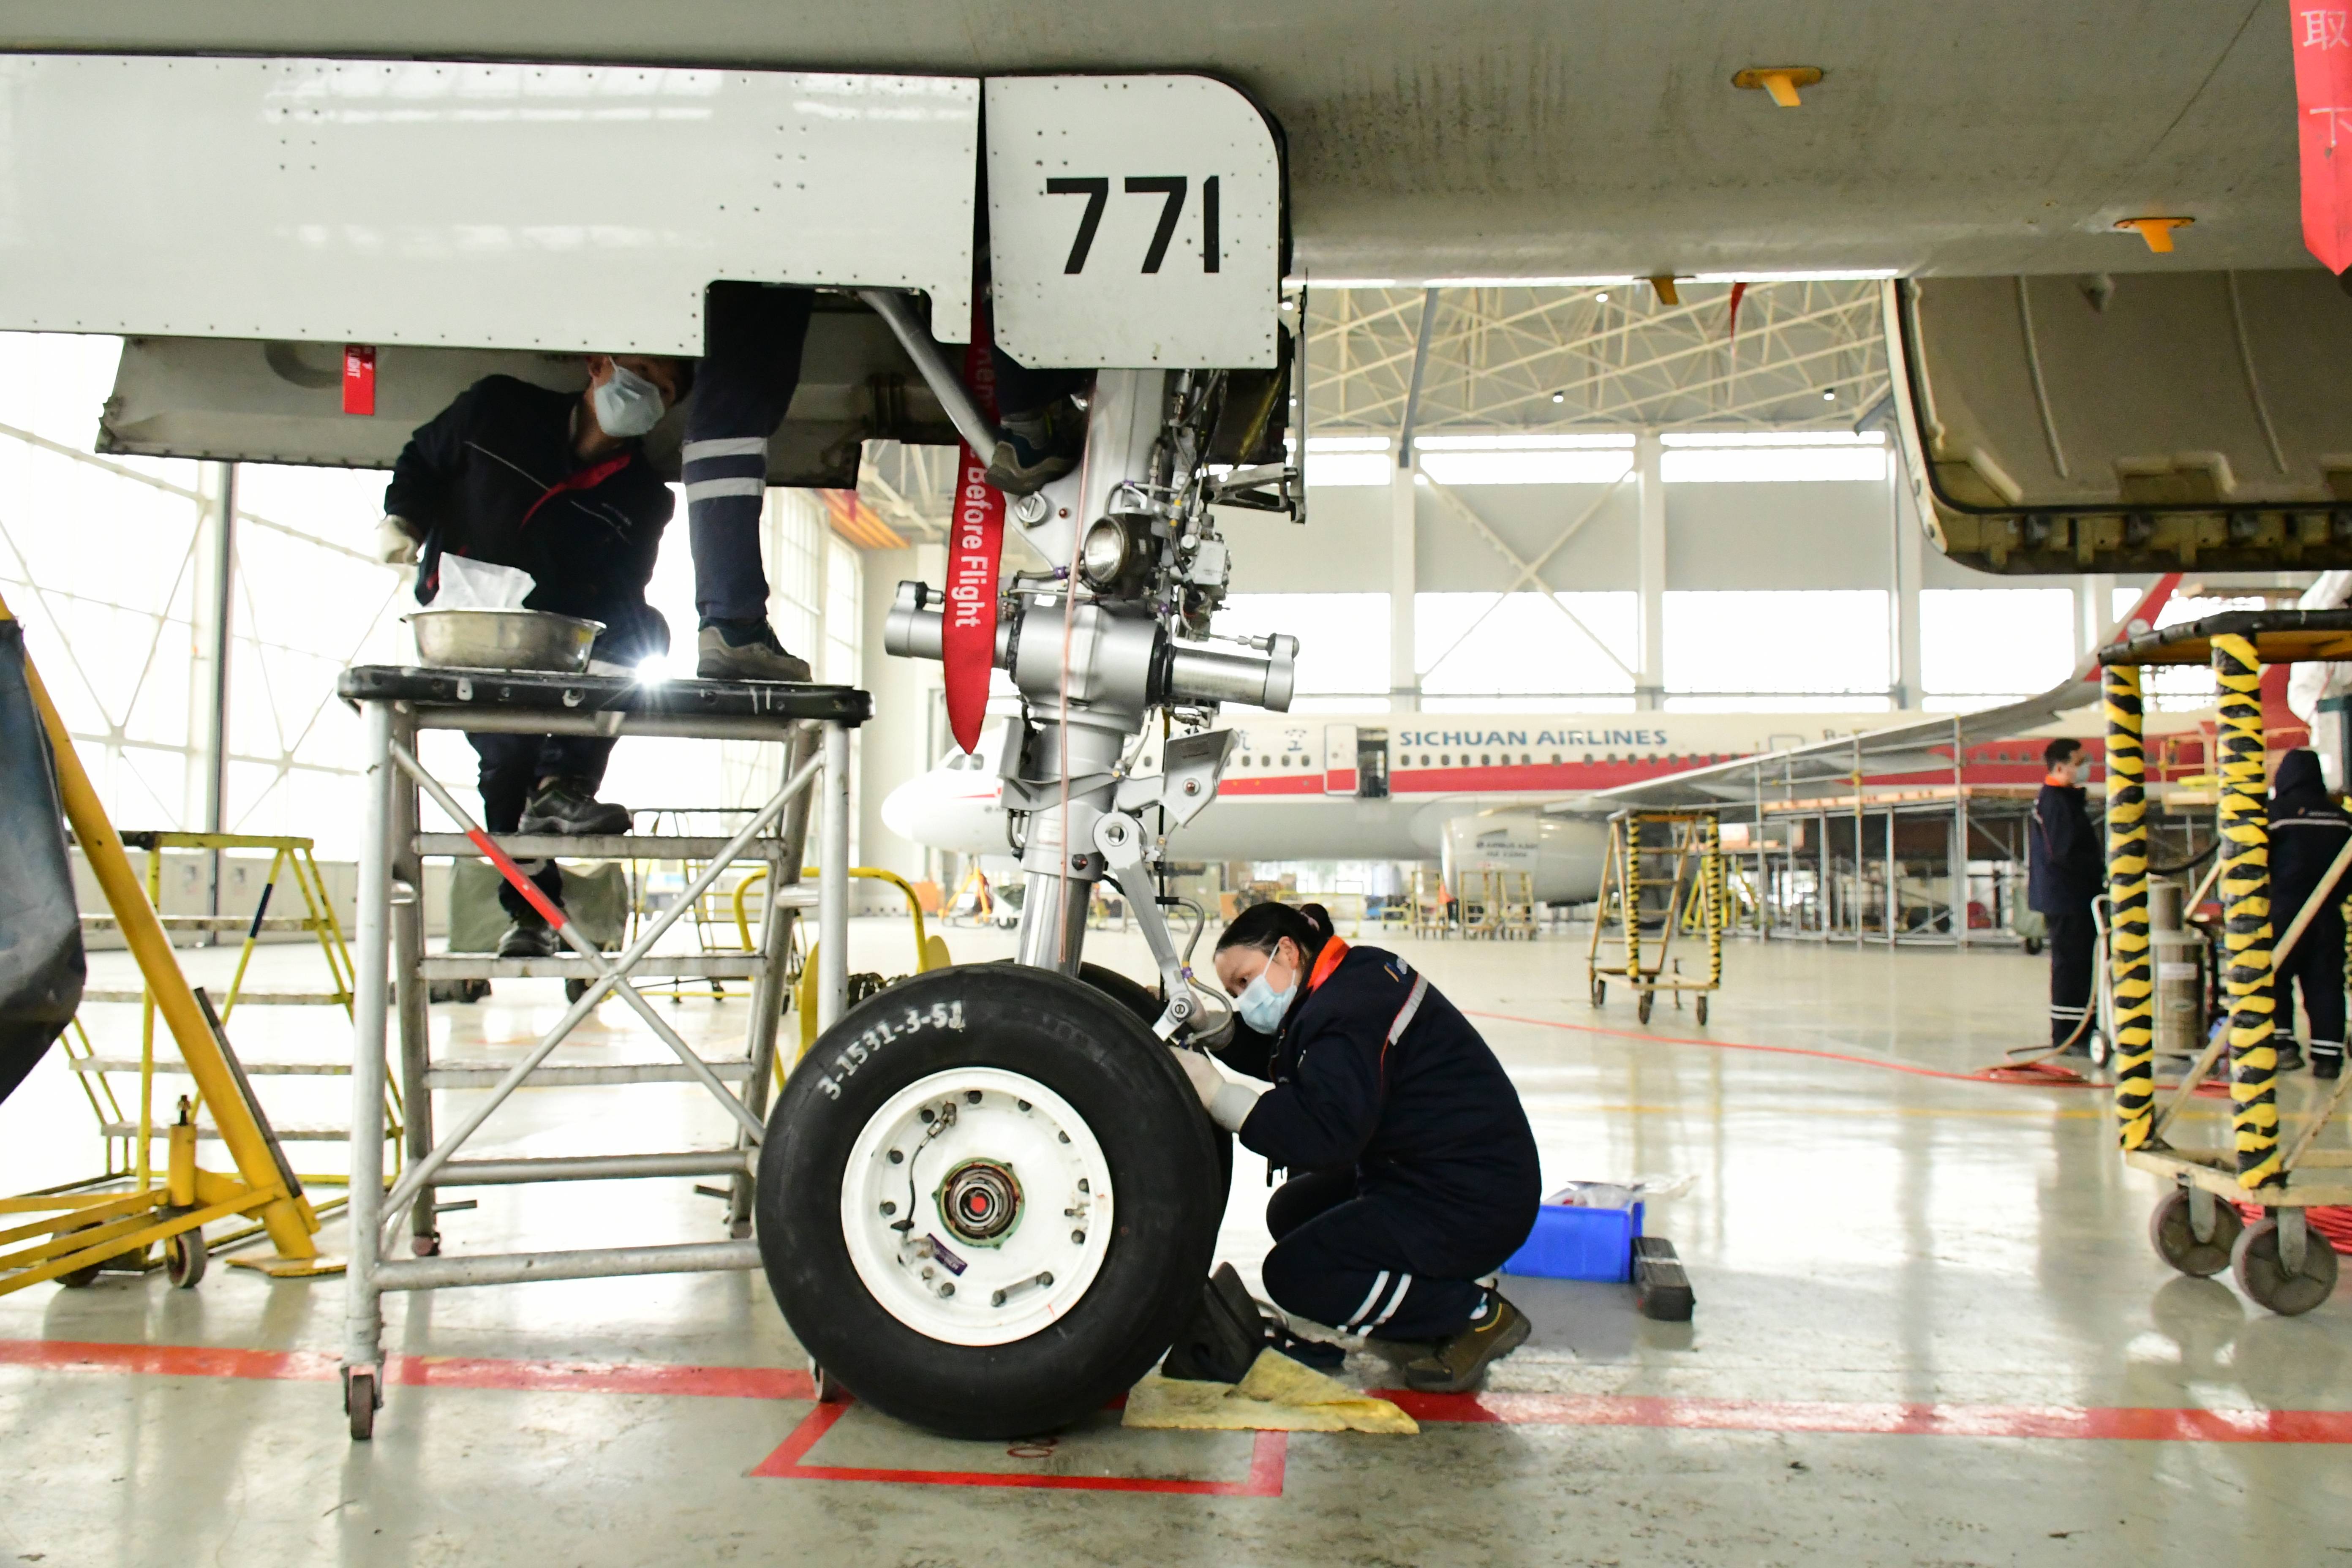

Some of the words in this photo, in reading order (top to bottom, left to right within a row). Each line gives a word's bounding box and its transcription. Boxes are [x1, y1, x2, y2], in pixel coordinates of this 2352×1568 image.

[1046, 175, 1220, 274] 771
[961, 466, 993, 549] Before
[951, 555, 989, 628] Flight
[1399, 730, 1527, 746] SICHUAN
[1536, 730, 1667, 746] AIRLINES
[817, 1000, 966, 1100] 3-1531-3-51
